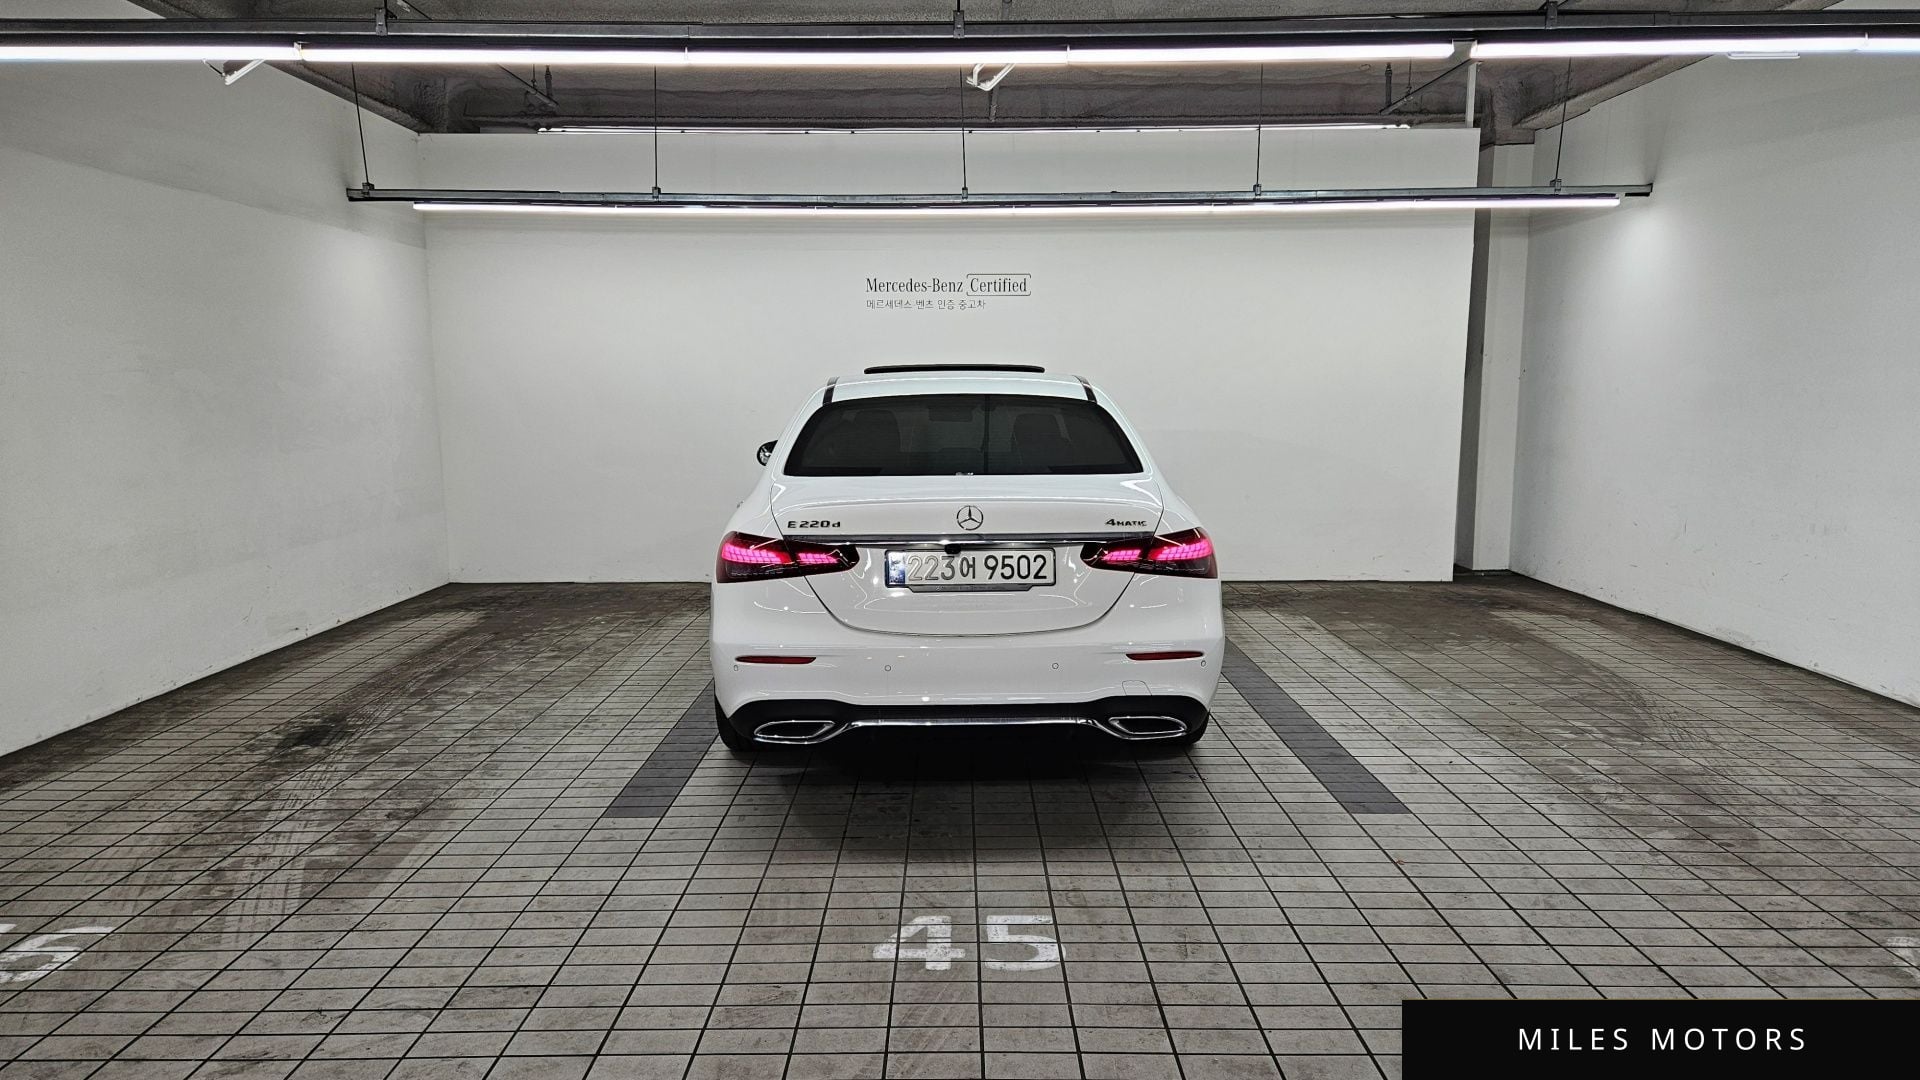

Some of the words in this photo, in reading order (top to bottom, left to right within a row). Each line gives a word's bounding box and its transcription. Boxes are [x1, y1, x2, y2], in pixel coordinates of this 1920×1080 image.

[866, 277, 963, 293] Mercedes-Benz
[970, 277, 1027, 293] Certified
[866, 299, 912, 310] 메르세데스
[916, 299, 934, 310] 벤츠
[937, 299, 955, 310] 인증
[958, 299, 986, 310] 중고차
[787, 520, 797, 529] E
[1105, 518, 1147, 527] 4MATIC
[907, 555, 976, 581] 223어
[984, 555, 1048, 580] 9502
[873, 915, 1066, 971] 45
